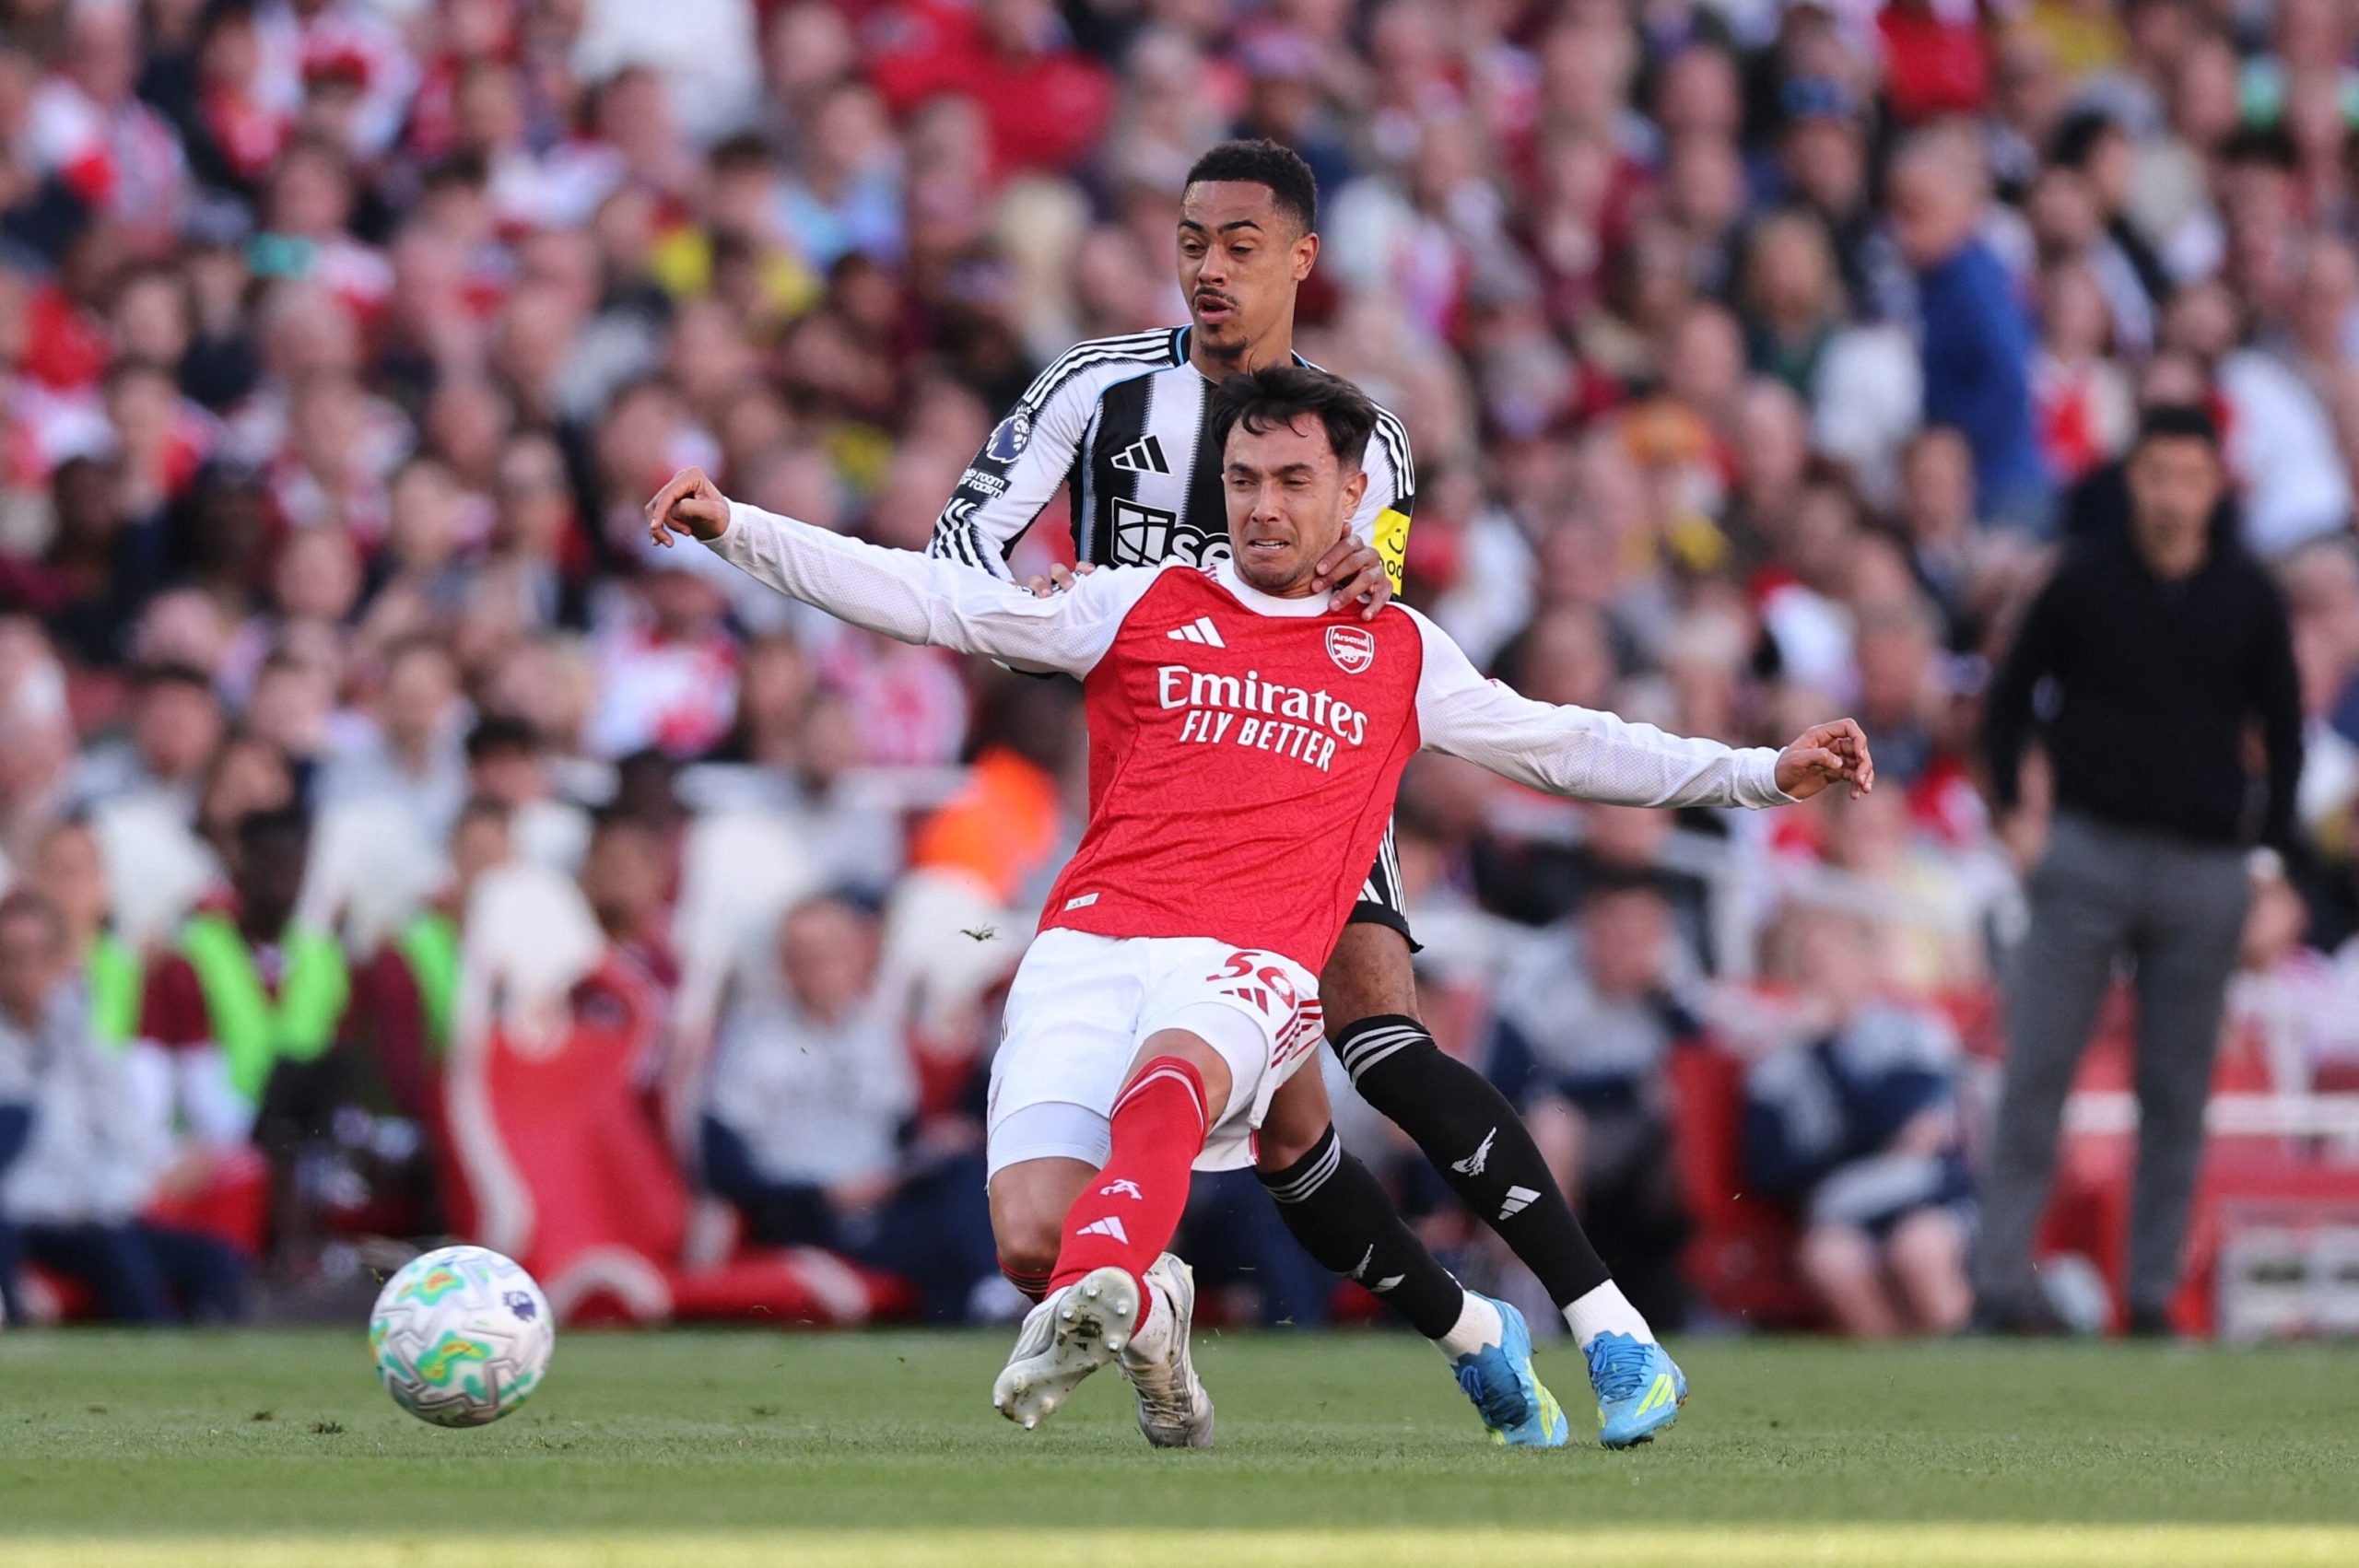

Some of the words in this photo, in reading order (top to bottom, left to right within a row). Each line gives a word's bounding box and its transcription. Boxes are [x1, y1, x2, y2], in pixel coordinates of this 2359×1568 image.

[975, 472, 1005, 489] room
[1172, 533, 1232, 568] se
[1332, 632, 1367, 647] Arsenal
[1157, 665, 1367, 745] Emirates
[1179, 710, 1234, 743] FLY
[1237, 717, 1336, 773] BETTER
